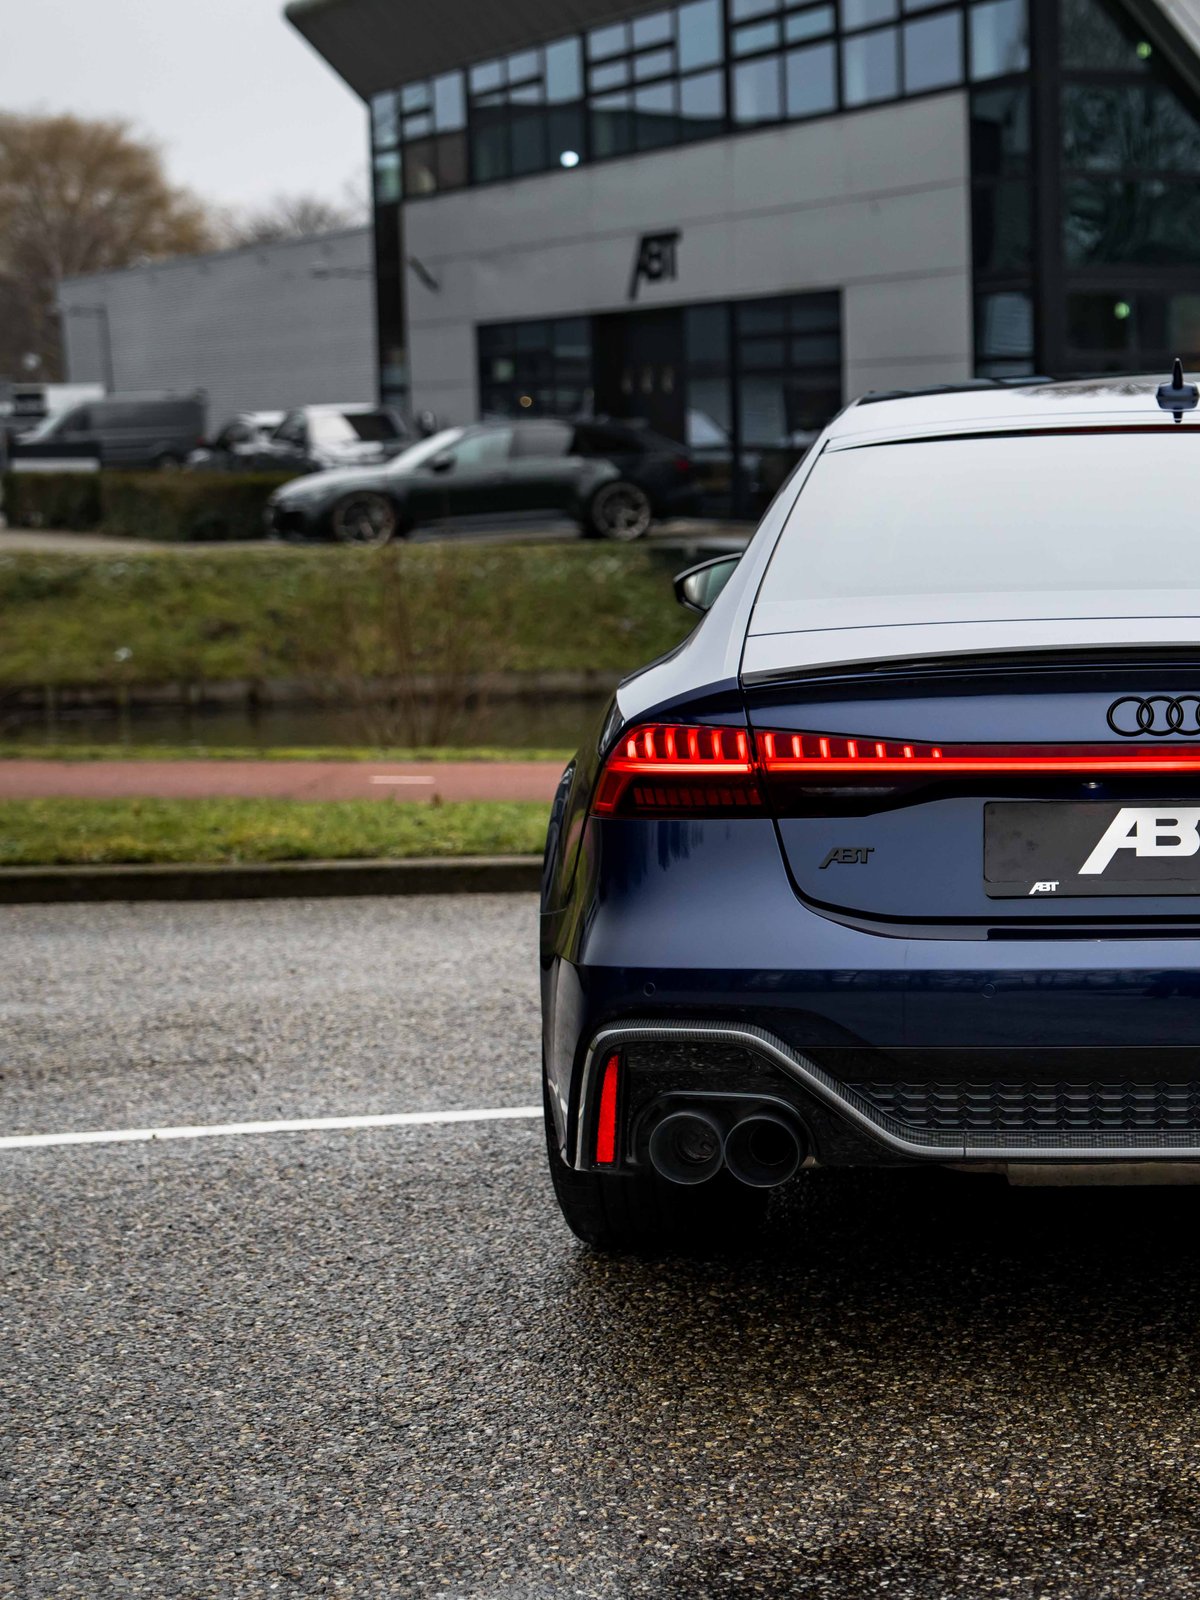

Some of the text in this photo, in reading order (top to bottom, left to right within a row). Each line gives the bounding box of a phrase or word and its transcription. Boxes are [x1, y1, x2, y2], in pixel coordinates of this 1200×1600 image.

[627, 231, 682, 300] ABT
[818, 847, 875, 870] ABT
[1028, 881, 1060, 895] ABT
